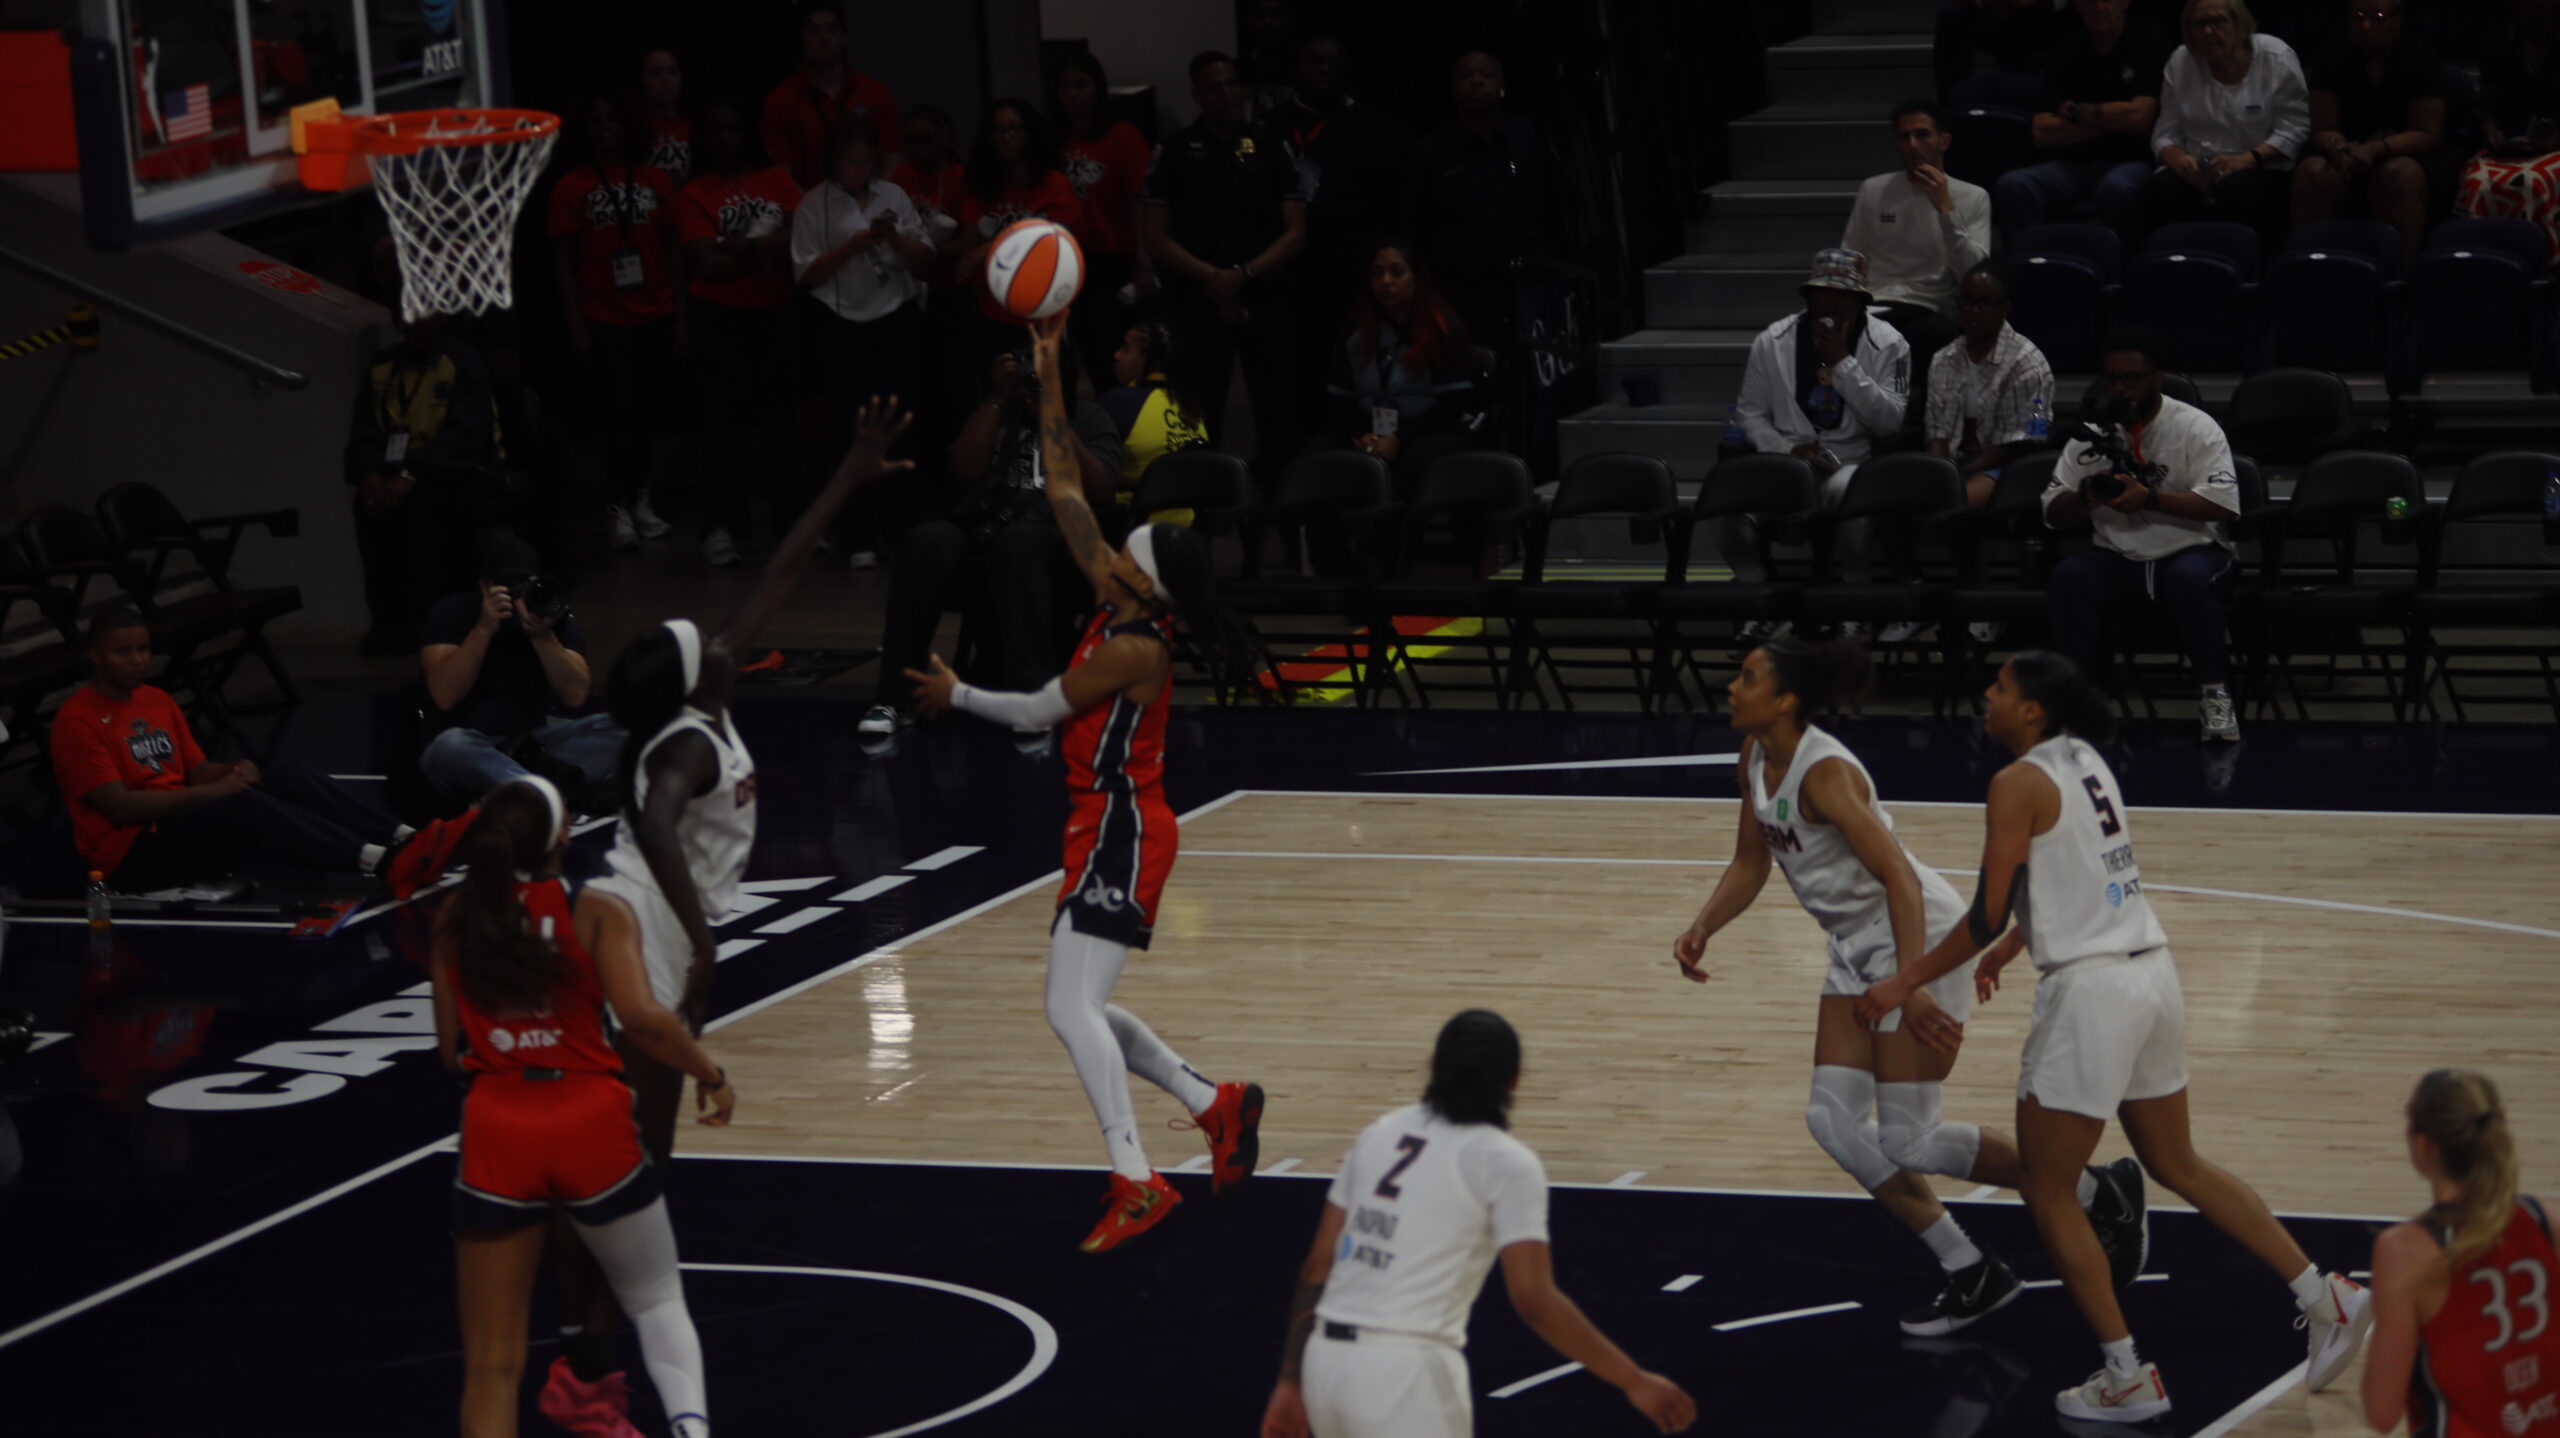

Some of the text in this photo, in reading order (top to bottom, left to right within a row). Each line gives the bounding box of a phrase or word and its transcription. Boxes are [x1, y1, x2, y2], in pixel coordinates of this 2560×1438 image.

[423, 39, 463, 76] AT&T
[2082, 775, 2121, 837] 5
[1375, 1134, 1428, 1199] 2
[2469, 1257, 2551, 1352] 33
